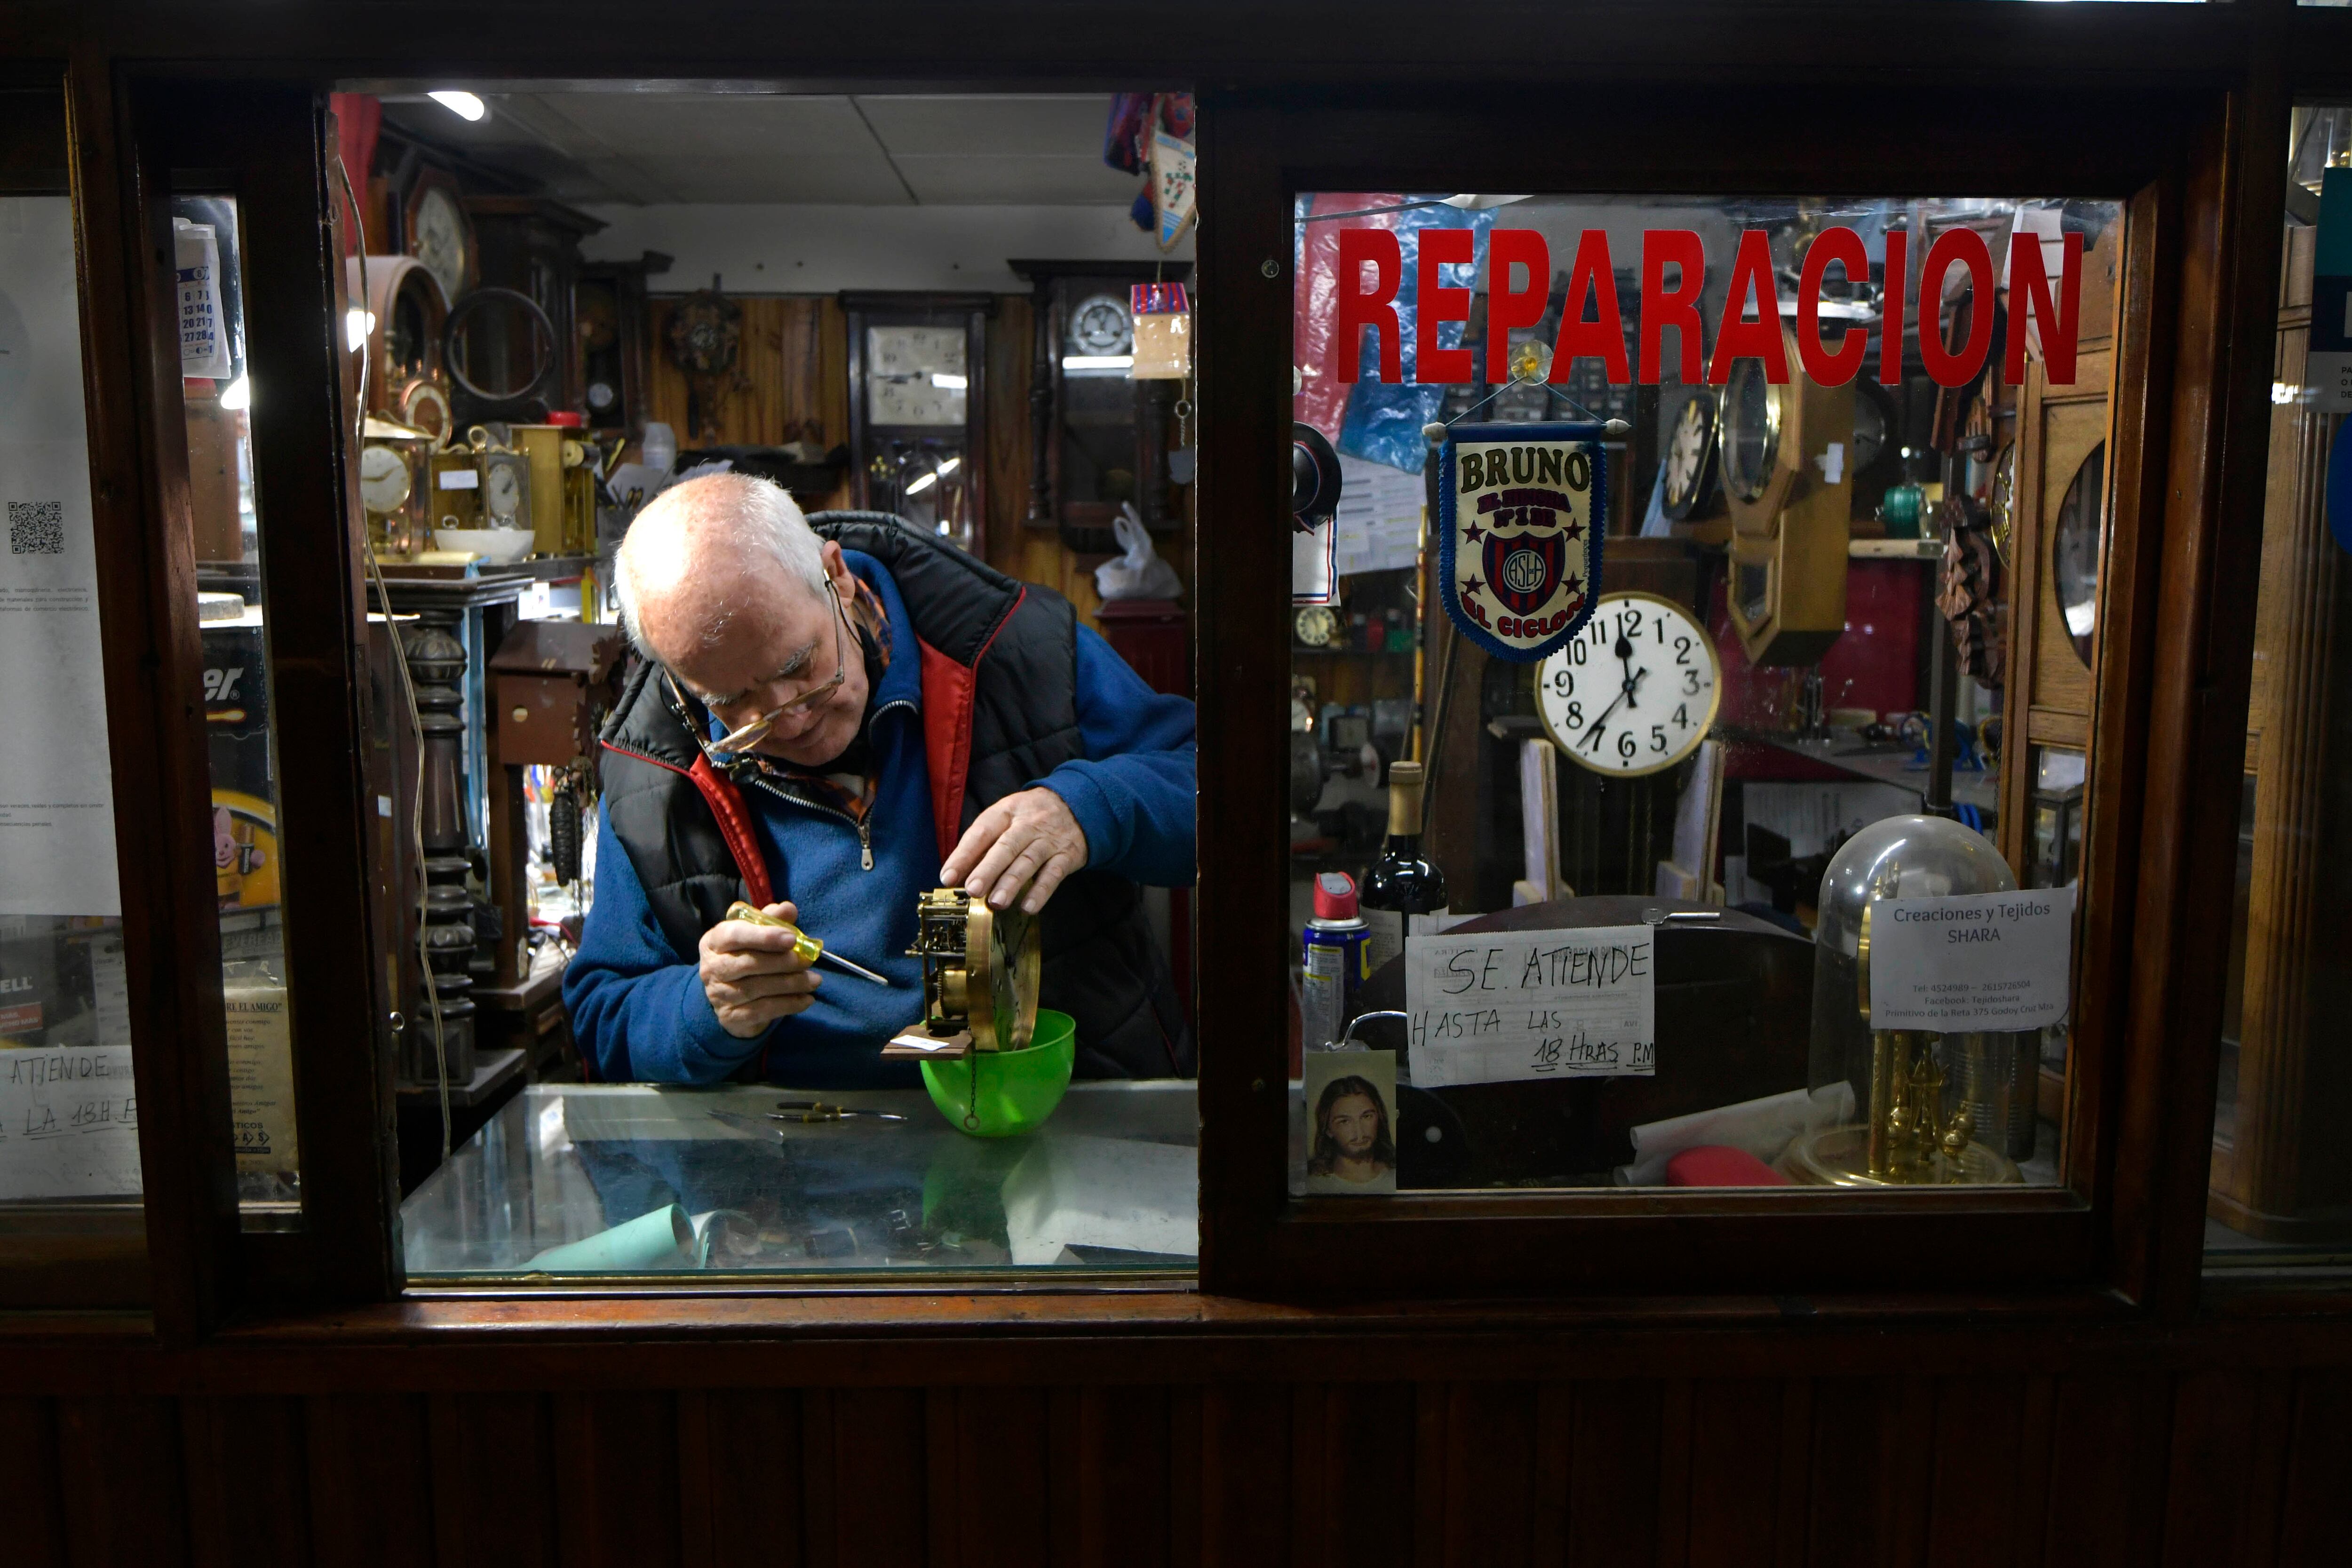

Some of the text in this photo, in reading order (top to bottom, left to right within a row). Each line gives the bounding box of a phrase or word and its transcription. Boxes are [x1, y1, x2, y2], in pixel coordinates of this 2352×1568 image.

[183, 306, 193, 315] 13
[1338, 227, 2083, 388] REPARACION
[183, 318, 194, 328] 20
[196, 317, 205, 327] 21
[184, 332, 194, 342] 27
[1461, 447, 1589, 493] BRUNO
[1460, 591, 1585, 638] EL CICLON
[1615, 609, 1643, 637] 12
[1590, 620, 1606, 645] 11
[1653, 618, 1664, 644] 1
[1566, 638, 1587, 666] 10
[1674, 637, 1691, 665] 2
[1554, 670, 1574, 698] 9
[1683, 669, 1700, 696] 3
[1566, 701, 1584, 730] 8
[1671, 703, 1688, 730] 4
[1587, 725, 1606, 752] 7
[1618, 731, 1636, 758] 6
[1650, 725, 1667, 752] 5
[1894, 901, 2050, 923] Creaciones y Tejidos
[1948, 929, 2001, 944] SHARA
[1521, 943, 1650, 989] ATIENDE
[1913, 984, 1929, 993] Tel:
[1931, 983, 1969, 993] 4524989
[1982, 980, 2031, 991] 2615726504
[1925, 995, 2020, 1005] Facebook: Tejidoshara
[1941, 1009, 1948, 1017] la
[1991, 1006, 2018, 1016] Godoy
[2020, 1004, 2036, 1013] Cruz
[1413, 1009, 1501, 1047] HASTA
[1528, 1011, 1562, 1029] LAS
[1534, 1038, 1563, 1063] 18
[1569, 1032, 1618, 1063] HRAS
[11, 1054, 109, 1084] ATIENDE
